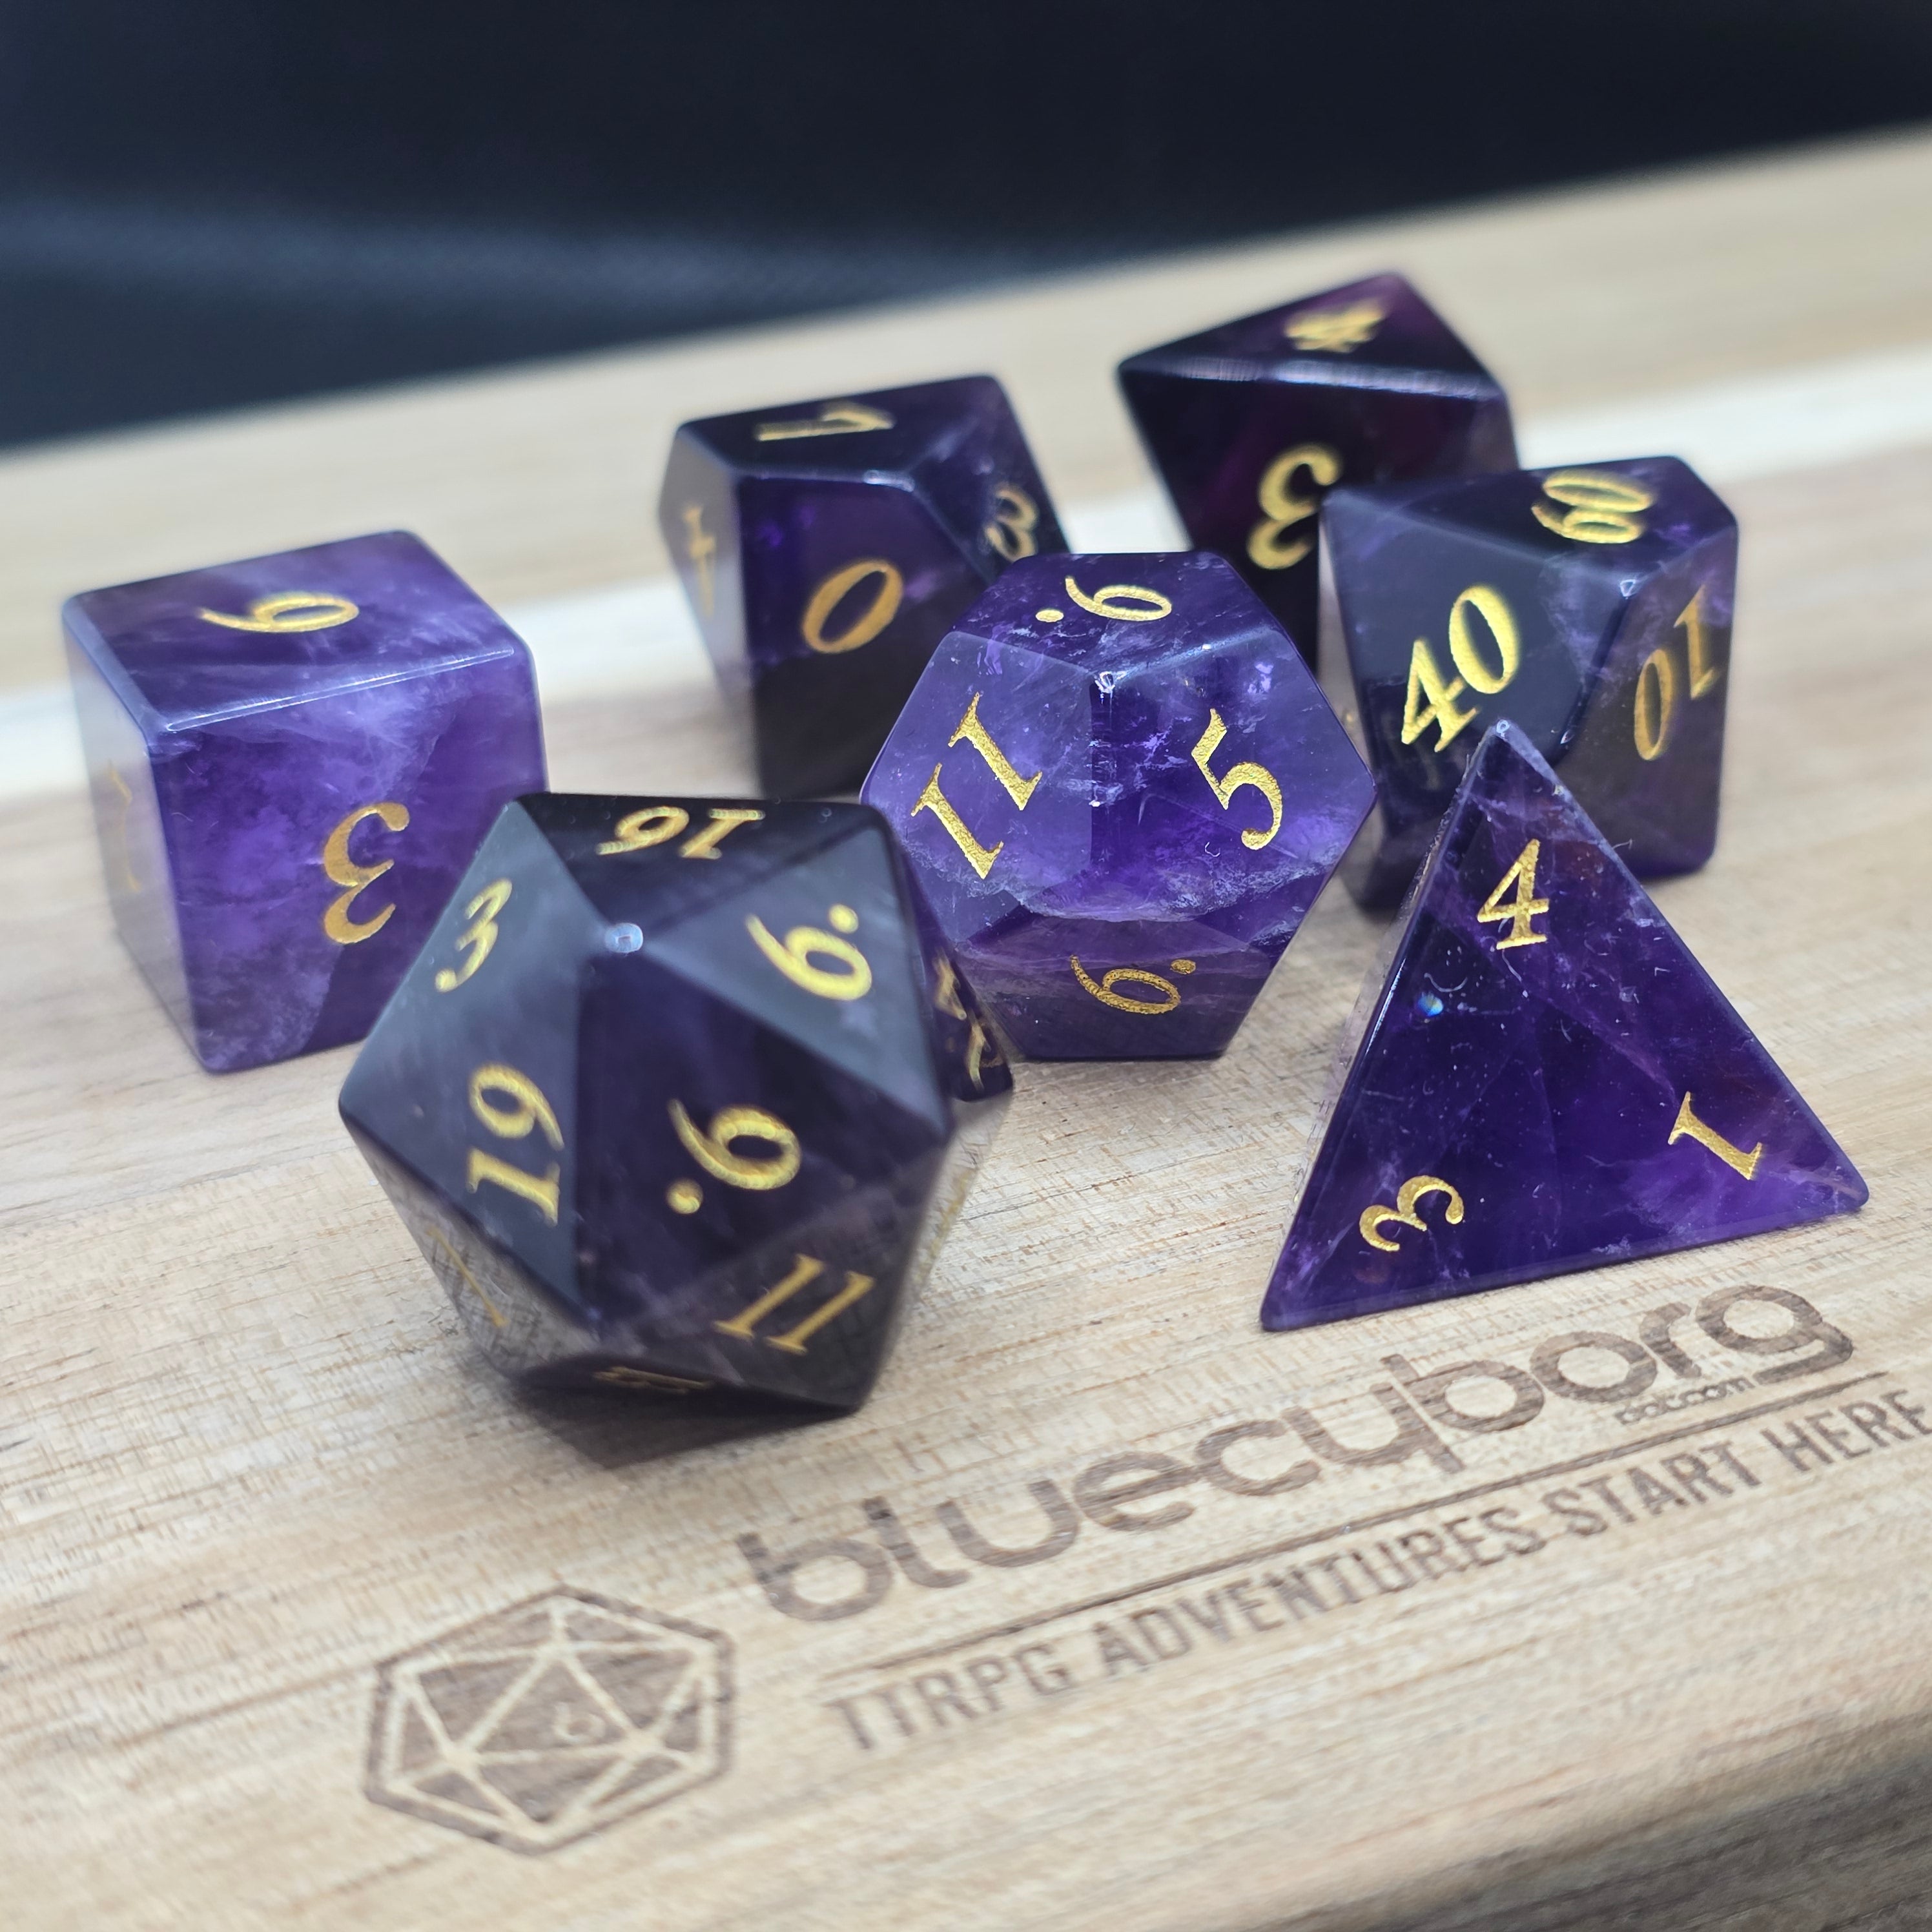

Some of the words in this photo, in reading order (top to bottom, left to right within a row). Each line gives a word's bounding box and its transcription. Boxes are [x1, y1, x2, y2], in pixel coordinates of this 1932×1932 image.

[1247, 444, 1342, 570] 3
[1400, 584, 1521, 753] 40
[1632, 584, 1718, 762] 10
[597, 806, 766, 860] 16
[911, 692, 1043, 879] 11
[1191, 708, 1283, 850] 5
[323, 802, 411, 946] 3
[435, 878, 513, 992] 3
[1477, 838, 1549, 951] 4
[466, 1062, 564, 1226] 19
[1668, 1091, 1763, 1180] 1
[1359, 1175, 1464, 1251] 3
[715, 1254, 874, 1354] 11
[734, 1285, 1853, 1622] bluecyborg
[825, 1643, 1080, 1750] TTRPG
[1091, 1506, 1547, 1677] ADVENTURES
[1543, 1440, 1763, 1536] START
[1760, 1389, 1932, 1473] HERE
